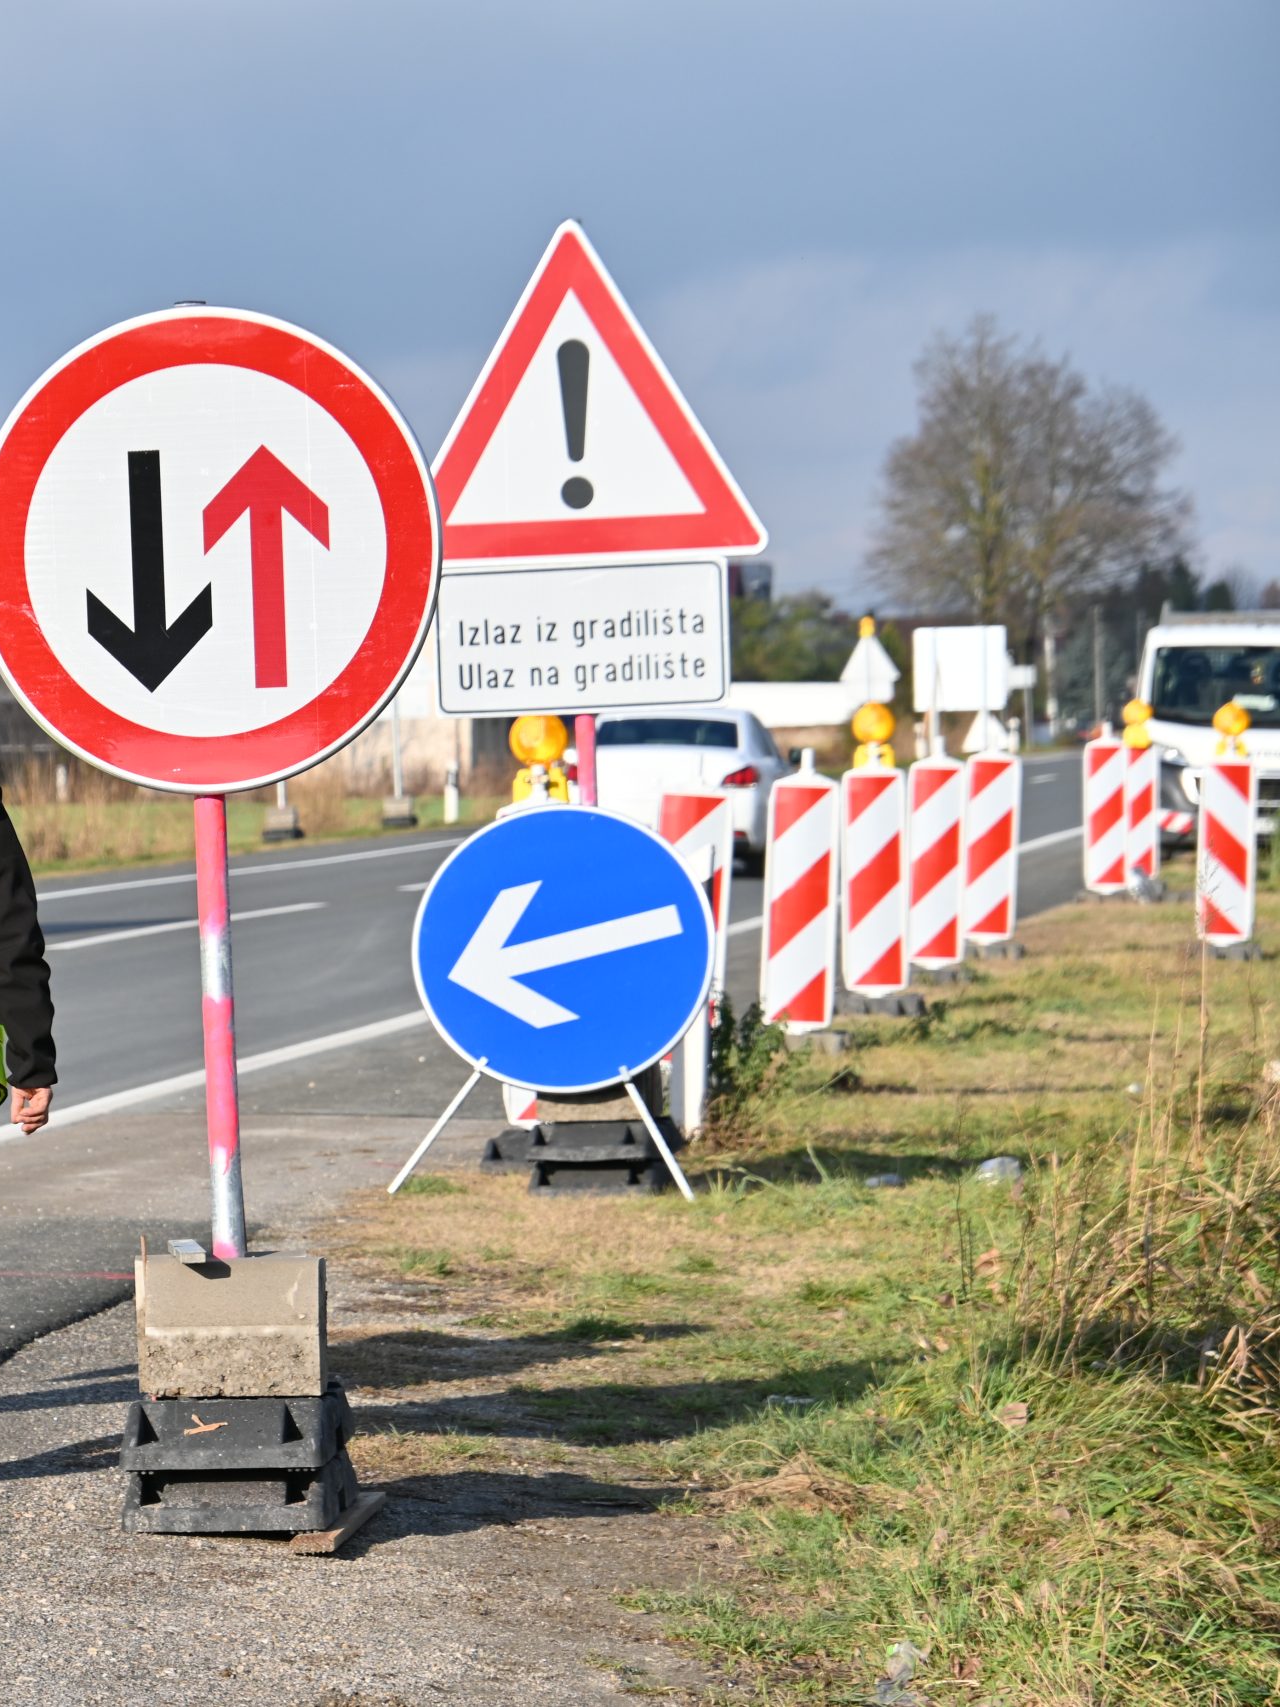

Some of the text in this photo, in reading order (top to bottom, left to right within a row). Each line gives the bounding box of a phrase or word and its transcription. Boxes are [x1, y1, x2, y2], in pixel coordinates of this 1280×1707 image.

[458, 608, 705, 648] Izlaz iz gradilišta
[458, 652, 706, 692] Ulaz na gradilište
